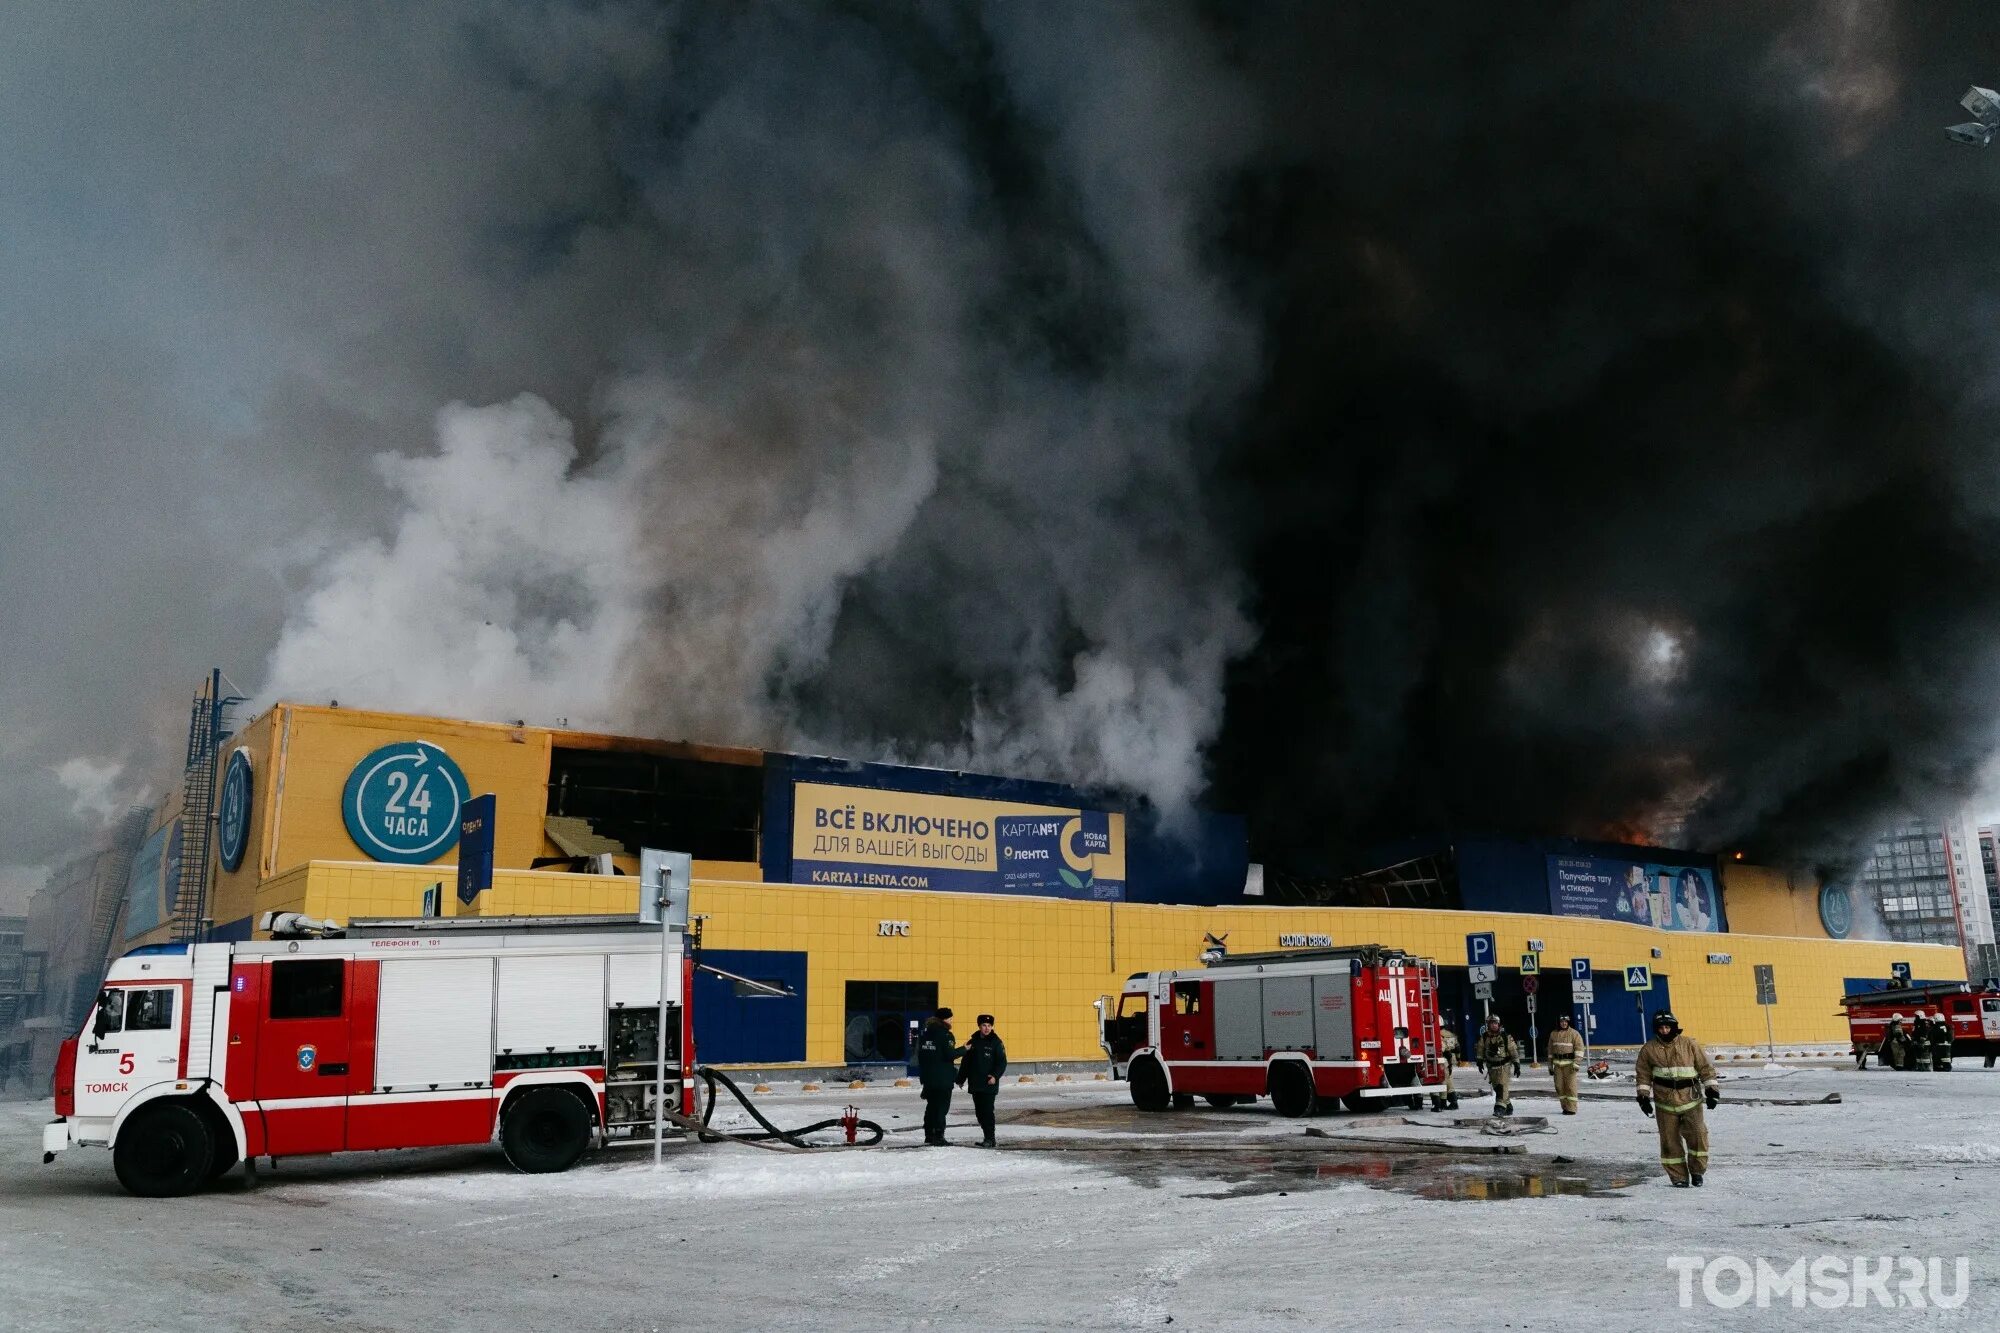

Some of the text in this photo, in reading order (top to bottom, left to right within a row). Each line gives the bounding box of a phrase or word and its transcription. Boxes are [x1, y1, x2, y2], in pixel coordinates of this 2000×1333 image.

[385, 771, 431, 815] 24
[384, 816, 429, 836] ЧАСА
[815, 805, 989, 840] ВСЁ ВКЛЮЧЕНО
[1083, 831, 1108, 842] НОВАЯ
[1085, 839, 1106, 849] КАРТА
[813, 835, 988, 864] ДЛЯ ВАШЕЙ ВЫГОДЫ
[1014, 848, 1049, 860] лента
[812, 870, 928, 888] KARTA1.LENTA.COM
[1559, 869, 1612, 886] Получайте тату
[1560, 884, 1595, 896] и стикеры
[877, 920, 912, 937] KFC
[1280, 934, 1333, 947] САЛОН СВЯЗИ
[1409, 990, 1415, 1002] 7
[119, 1053, 135, 1075] 5
[85, 1082, 129, 1094] ТОМСК
